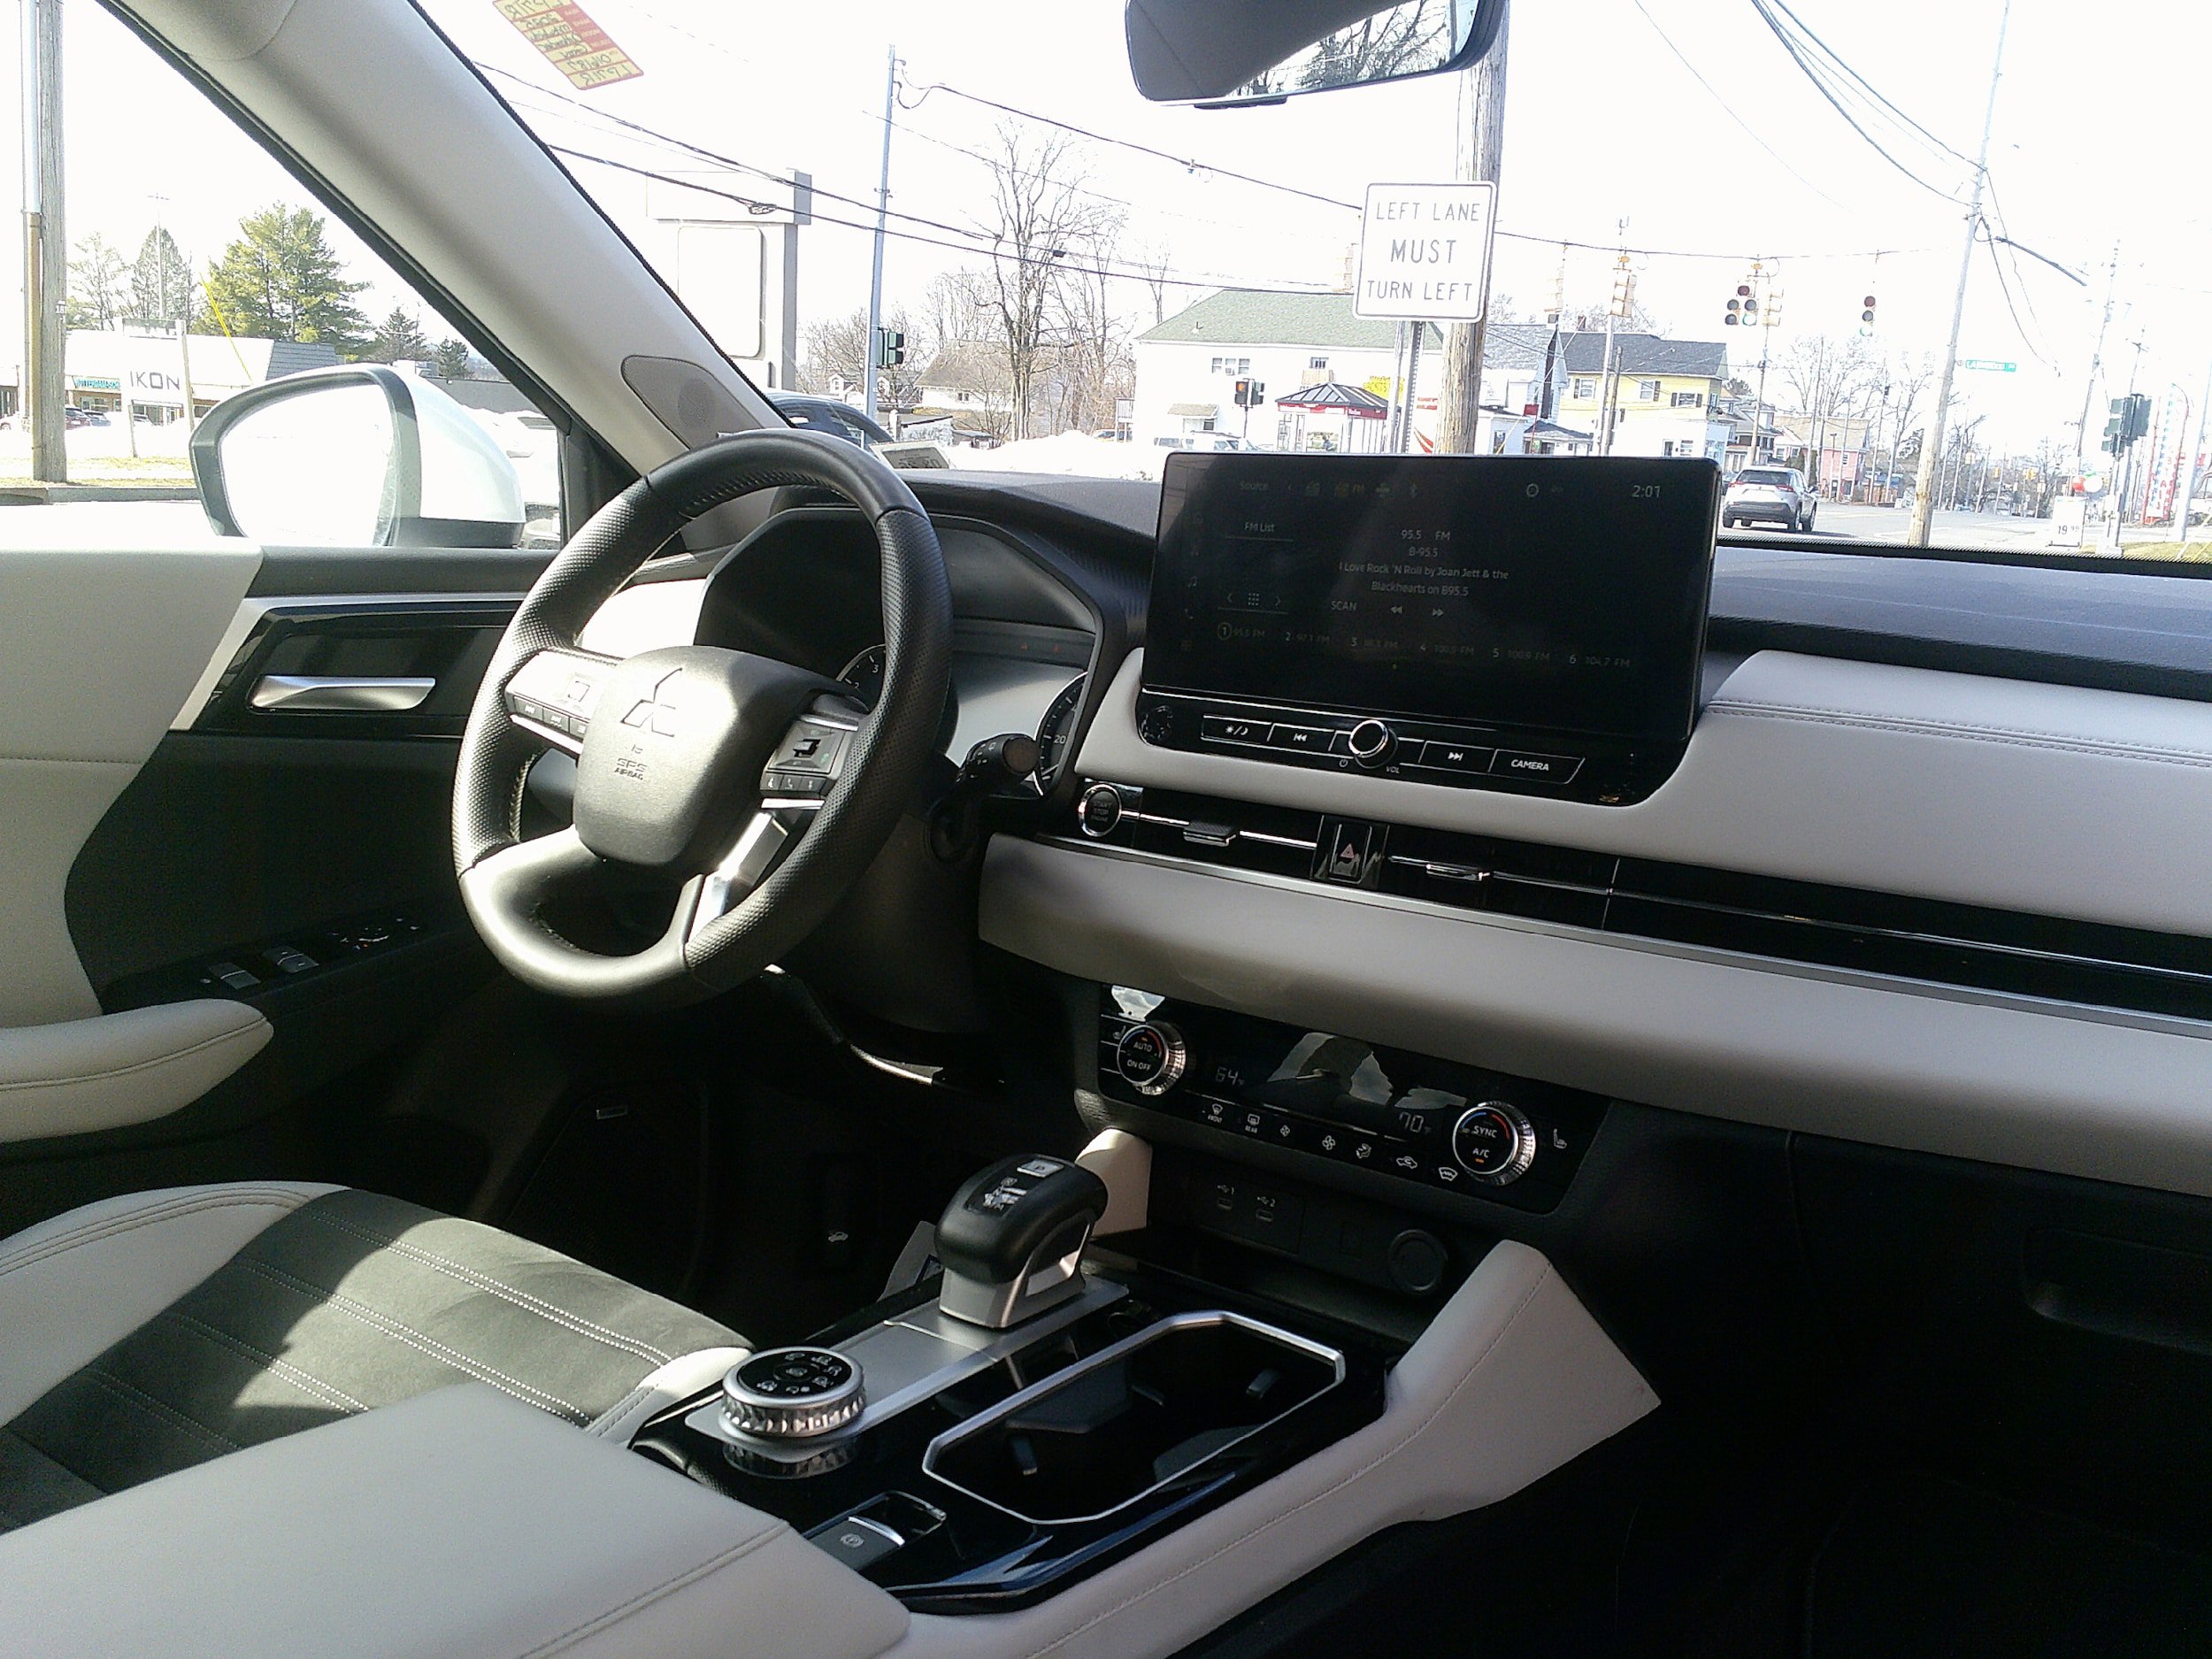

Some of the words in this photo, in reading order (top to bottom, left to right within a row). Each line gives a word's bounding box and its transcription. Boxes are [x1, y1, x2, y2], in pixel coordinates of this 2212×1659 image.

[1376, 202, 1420, 220] LEFT
[1432, 203, 1480, 221] LANE
[1390, 239, 1456, 264] MUST
[1367, 280, 1412, 299] TURN
[1424, 282, 1472, 301] LEFT
[130, 370, 180, 390] IKON
[1632, 484, 1662, 498] 2:01
[1244, 522, 1258, 532] FM
[1259, 522, 1275, 533] List
[1401, 530, 1422, 541] 95.5
[1434, 531, 1451, 541] FM
[1344, 562, 1364, 573] Love
[1367, 563, 1389, 574] Rock
[1404, 565, 1422, 575] Roll
[1424, 566, 1435, 578] by
[1437, 566, 1460, 578] Joan
[1461, 567, 1480, 579] Jett
[1481, 569, 1490, 579] &
[1492, 569, 1509, 580] the
[1371, 580, 1426, 595] Blackhearts
[1428, 585, 1440, 595] on
[1441, 585, 1469, 596] B95.5
[1331, 601, 1357, 611] SCAN
[1285, 631, 1291, 641] 2
[1351, 637, 1357, 647] 3
[1419, 642, 1426, 653] 4
[1492, 648, 1500, 658] 5
[1569, 653, 1577, 664] 6
[872, 664, 879, 673] 3
[1054, 734, 1066, 745] 20
[1385, 765, 1400, 774] VOL
[1509, 758, 1549, 772] CAMERA
[1133, 1041, 1152, 1053] AUTO
[1126, 1058, 1137, 1068] ON
[1138, 1061, 1151, 1071] OFF
[1244, 1125, 1258, 1134] REAR
[1472, 1125, 1497, 1139] SYNC
[1472, 1148, 1489, 1158] A/C
